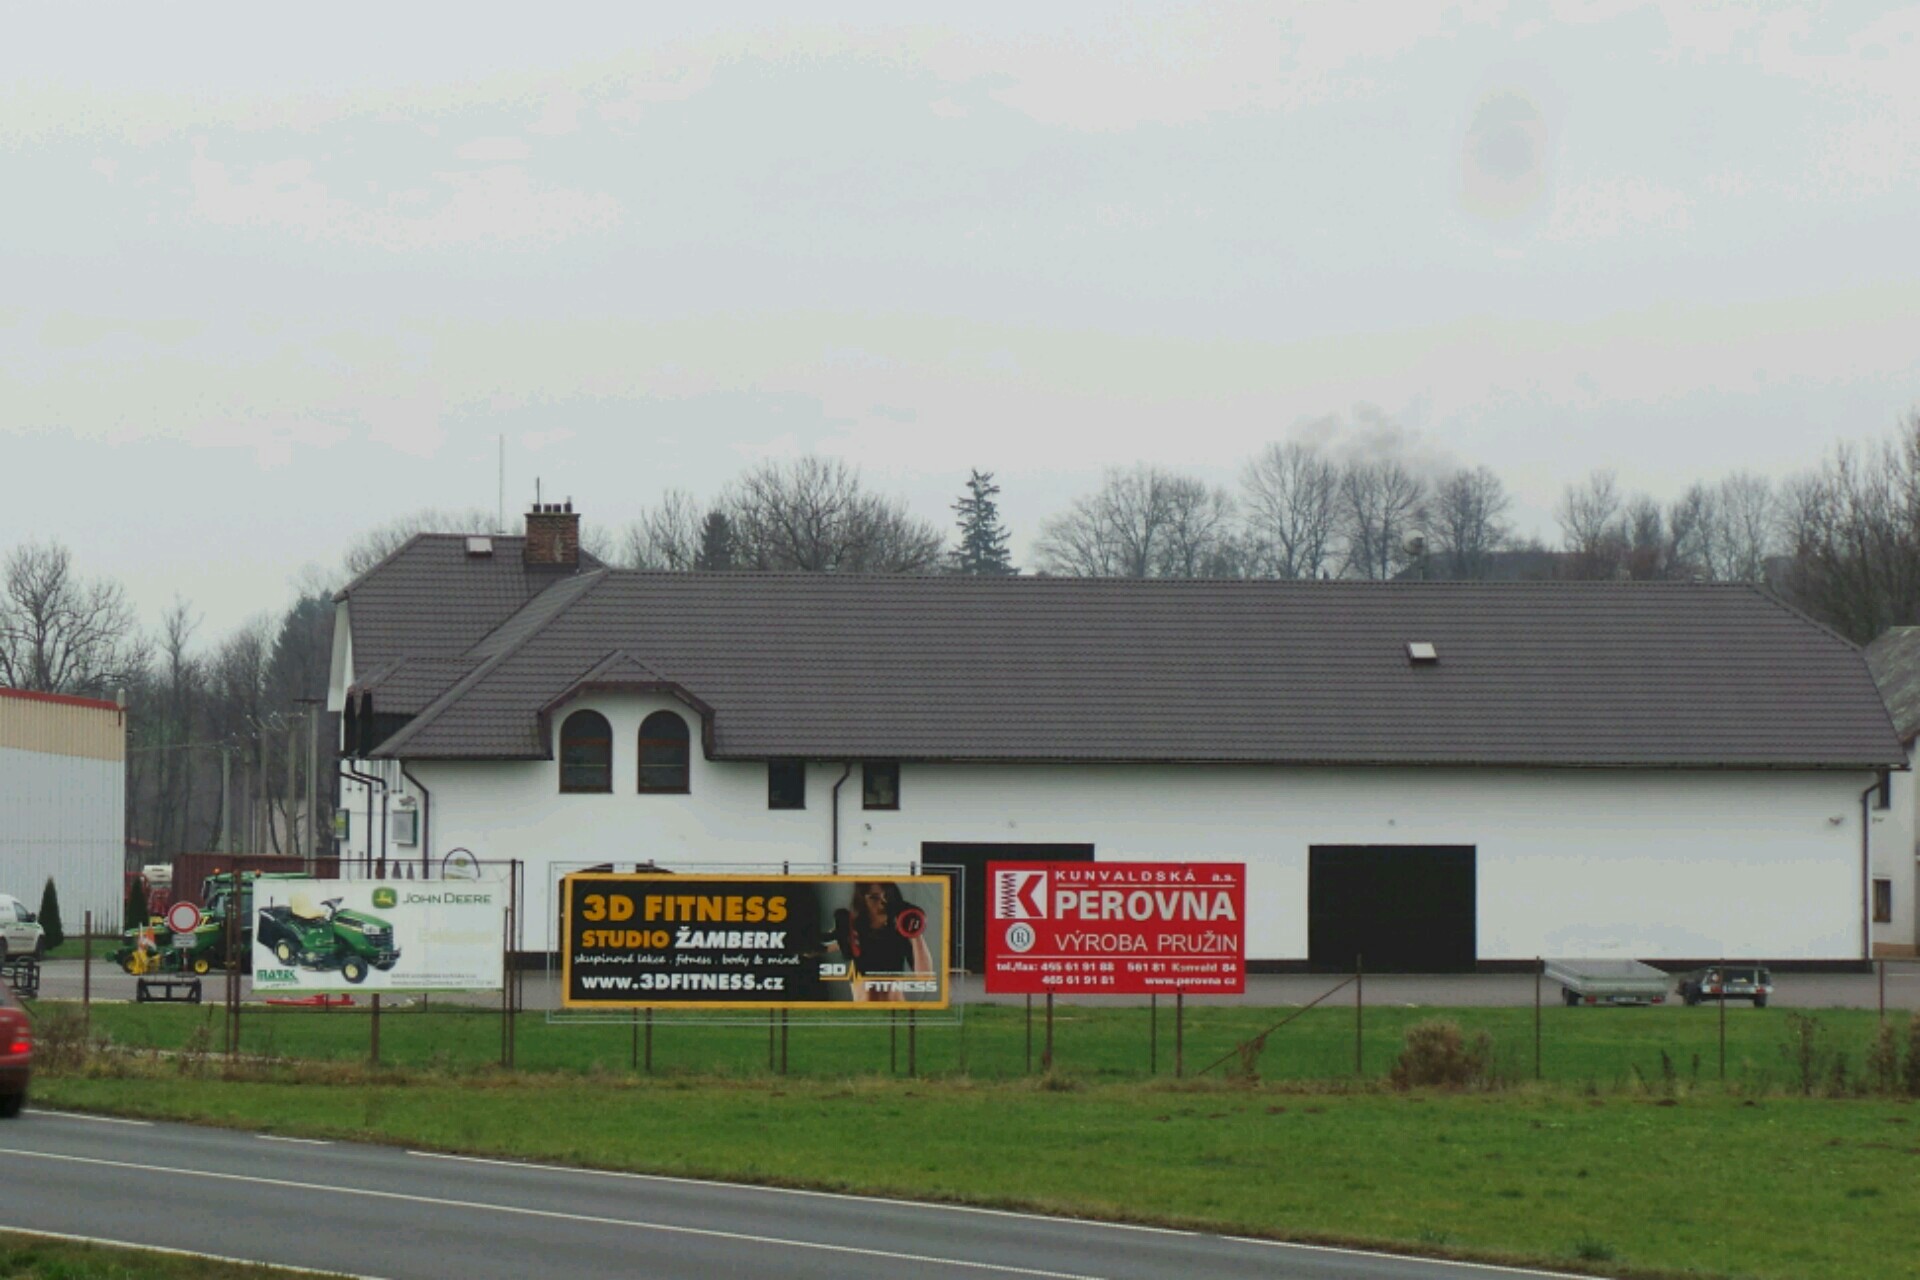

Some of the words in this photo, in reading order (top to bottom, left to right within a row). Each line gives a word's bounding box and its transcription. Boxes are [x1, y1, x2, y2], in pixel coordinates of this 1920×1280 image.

[1055, 870, 1196, 882] KUNVALDSKÁ
[1212, 874, 1237, 882] a.s.
[403, 892, 442, 904] JOHN
[444, 892, 492, 904] DEERE
[582, 894, 635, 922] 3D
[645, 895, 788, 922] FITNESS
[1055, 890, 1237, 921] PEROVNA
[581, 929, 669, 949] STUDIO
[674, 926, 787, 949] ŽAMBERK
[1054, 930, 1148, 952] VÝROBA
[1158, 930, 1238, 952] PRUŽIN
[637, 953, 666, 964] lekce
[674, 953, 712, 967] fitness
[722, 953, 750, 966] body
[754, 954, 764, 965] &
[767, 953, 800, 965] mind
[818, 963, 846, 976] 3D
[1065, 962, 1079, 972] 61
[581, 972, 785, 990] www.3DFITNESS.cz
[864, 980, 938, 992] FITNESS
[1066, 975, 1080, 985] 61
[1144, 977, 1237, 987] www.perovnacz
